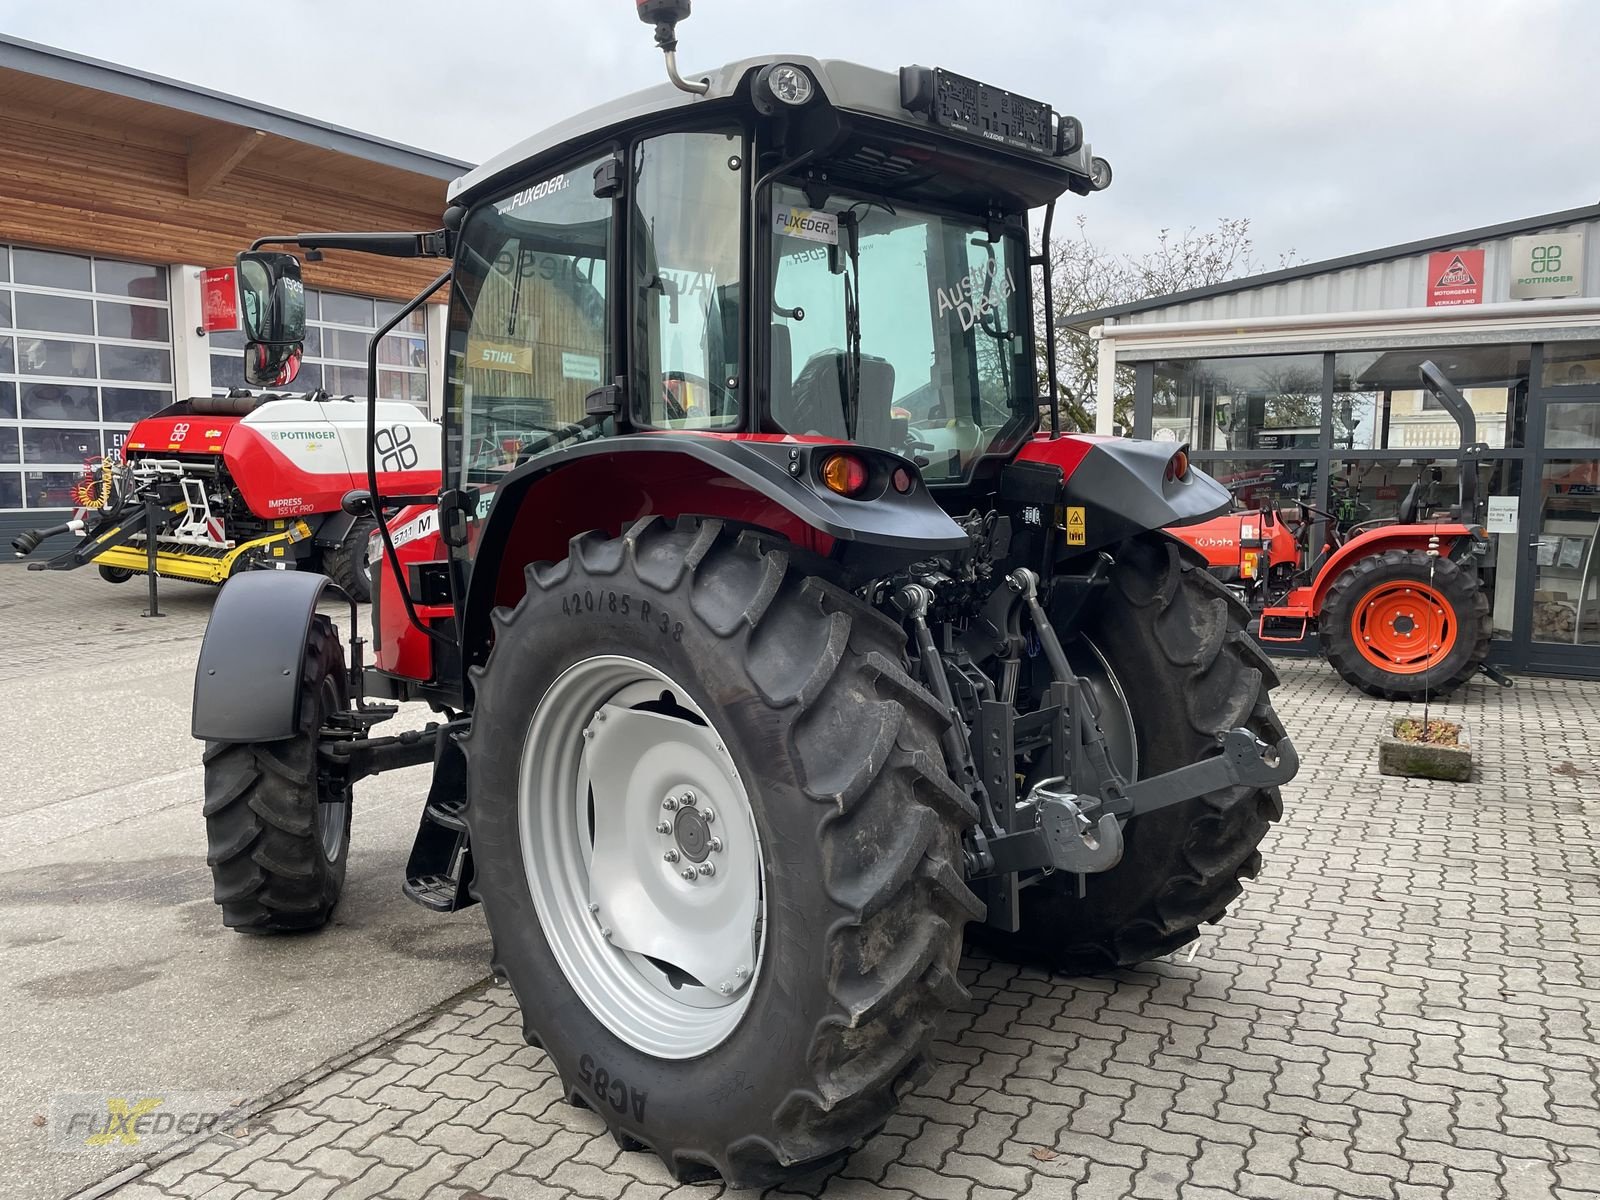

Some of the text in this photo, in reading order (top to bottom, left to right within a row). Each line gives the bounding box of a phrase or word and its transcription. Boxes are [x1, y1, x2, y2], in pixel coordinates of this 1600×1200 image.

[937, 258, 997, 318] Austro
[957, 267, 1016, 332] Diesel
[482, 349, 516, 364] STIHL
[268, 497, 302, 508] IMPRESS
[278, 506, 289, 515] 155
[299, 503, 314, 512] PRO
[394, 515, 431, 545] 5711 M
[1195, 538, 1233, 547] Kubota
[562, 590, 684, 642] 420/85 R 38
[578, 1053, 649, 1124] AC85
